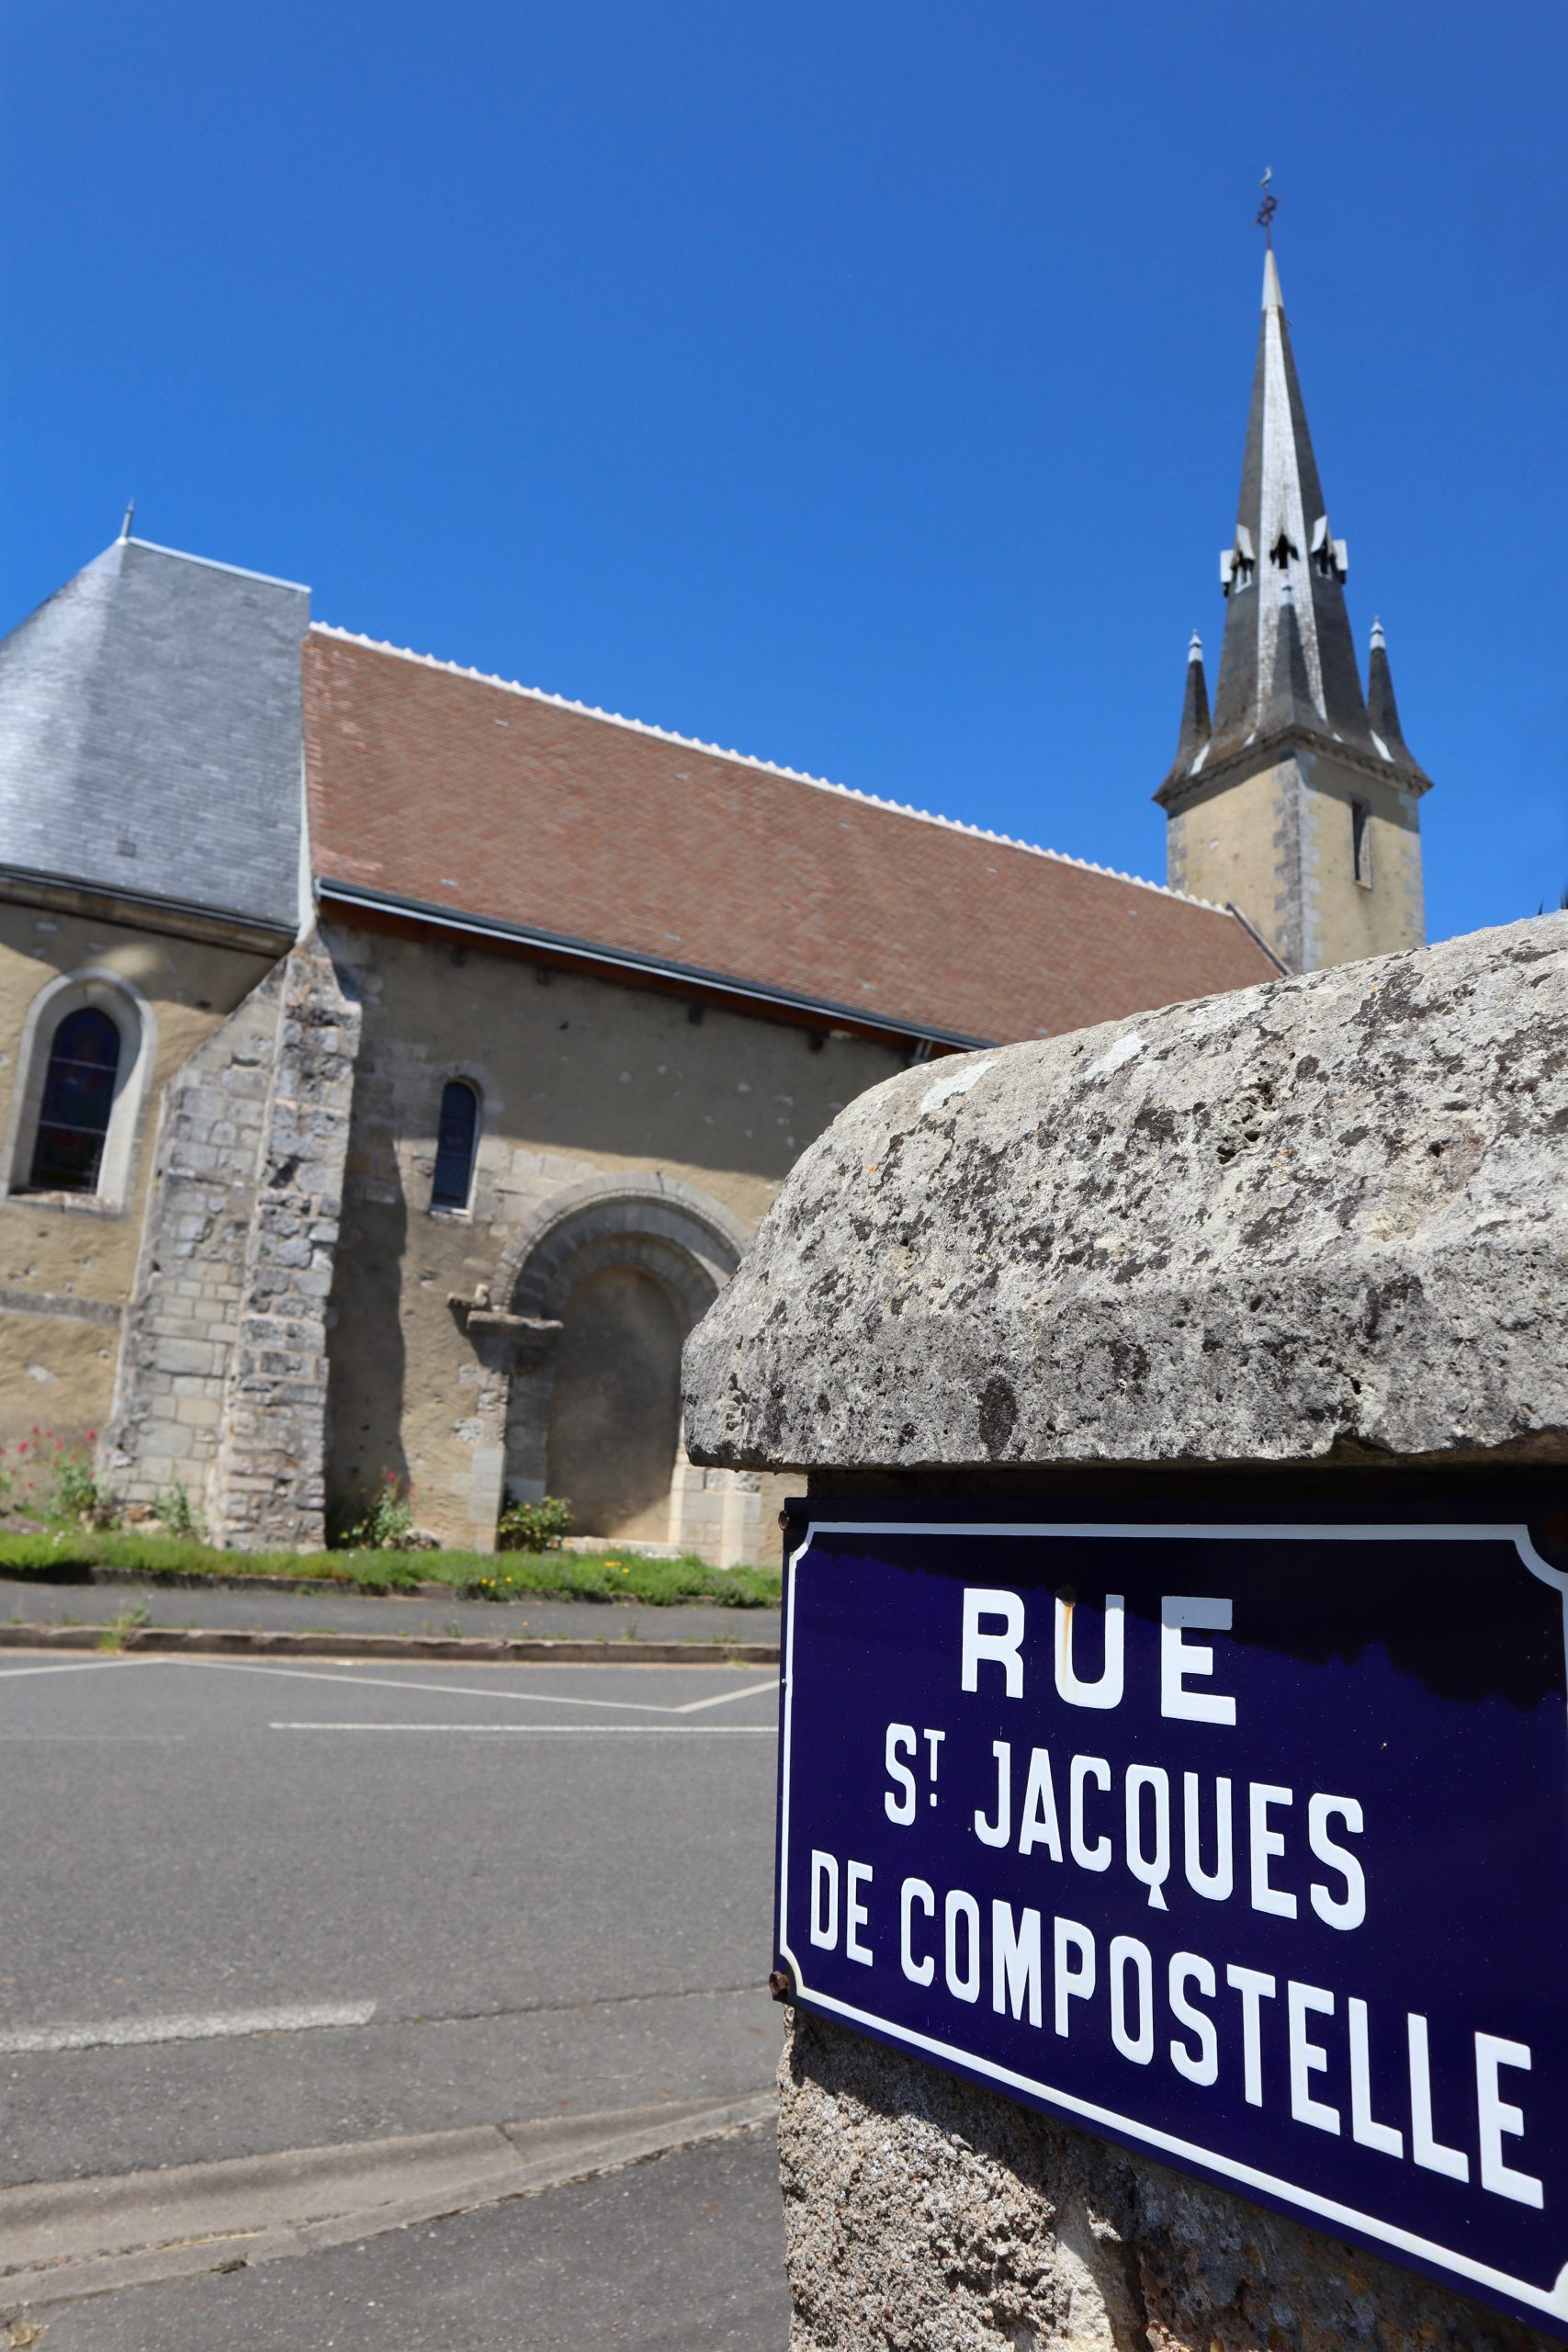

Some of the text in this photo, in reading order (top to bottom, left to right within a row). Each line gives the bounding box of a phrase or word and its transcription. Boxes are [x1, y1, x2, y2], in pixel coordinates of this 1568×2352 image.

[961, 1587, 1236, 1726] RUE
[974, 1740, 1367, 1931] JACQUES
[809, 1849, 1544, 2210] DE COMPOSTELLE
